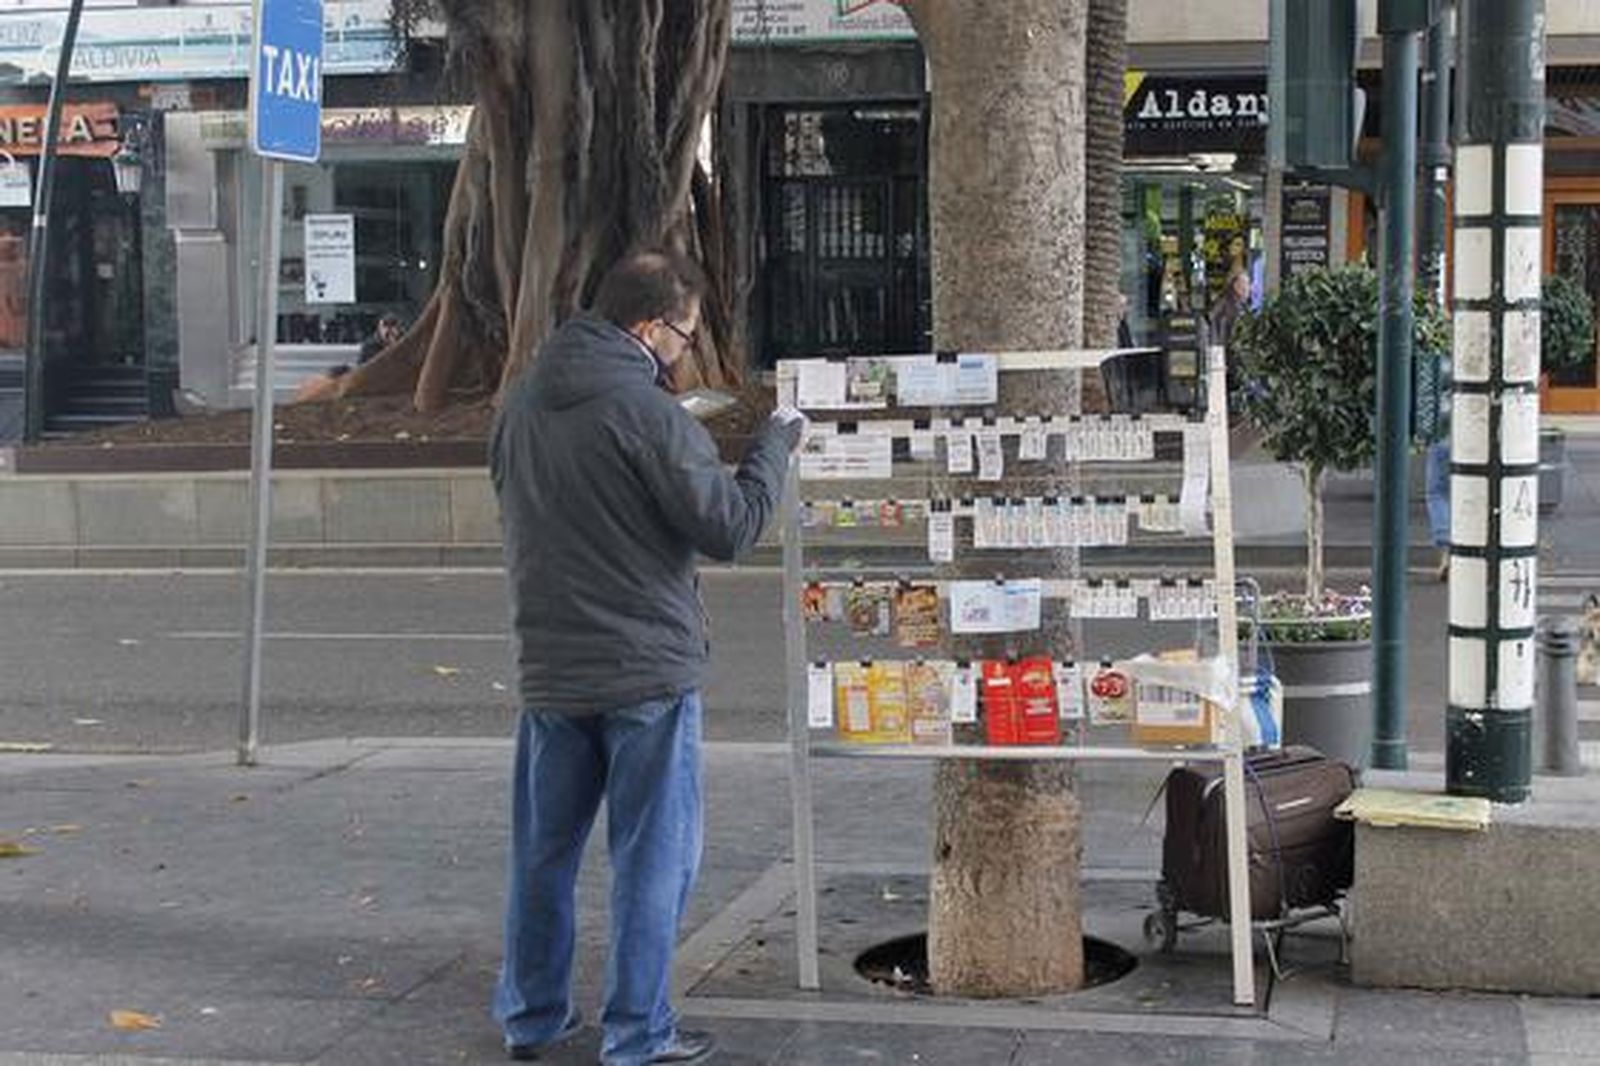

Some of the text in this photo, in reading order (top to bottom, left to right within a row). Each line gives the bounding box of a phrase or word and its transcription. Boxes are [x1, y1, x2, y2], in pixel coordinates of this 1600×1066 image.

[73, 48, 161, 69] ALDIVIA
[262, 44, 318, 102] TAXI
[0, 114, 94, 144] NEA
